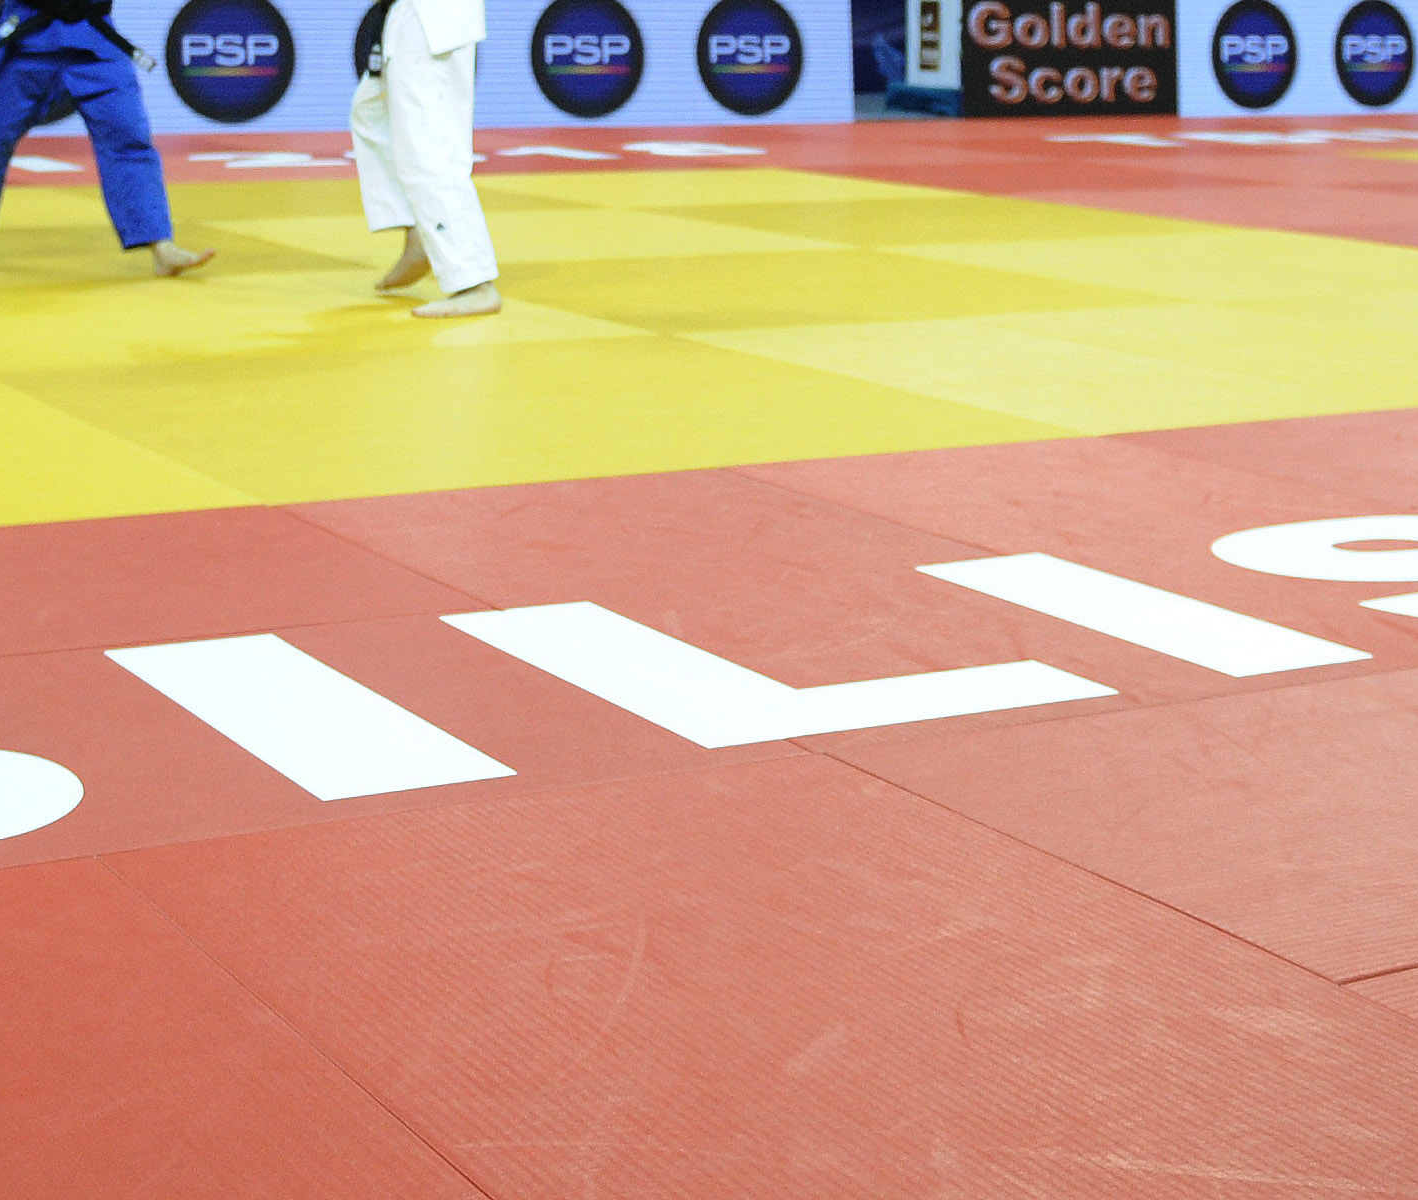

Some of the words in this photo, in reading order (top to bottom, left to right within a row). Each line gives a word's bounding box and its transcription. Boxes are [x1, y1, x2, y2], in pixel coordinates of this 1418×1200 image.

[967, 0, 1171, 52] Golden
[181, 32, 280, 68] PSP
[543, 33, 631, 66] PSP
[708, 33, 792, 65] PSP
[1219, 34, 1289, 63] PSP
[1341, 34, 1408, 63] PSP
[988, 55, 1159, 104] Score
